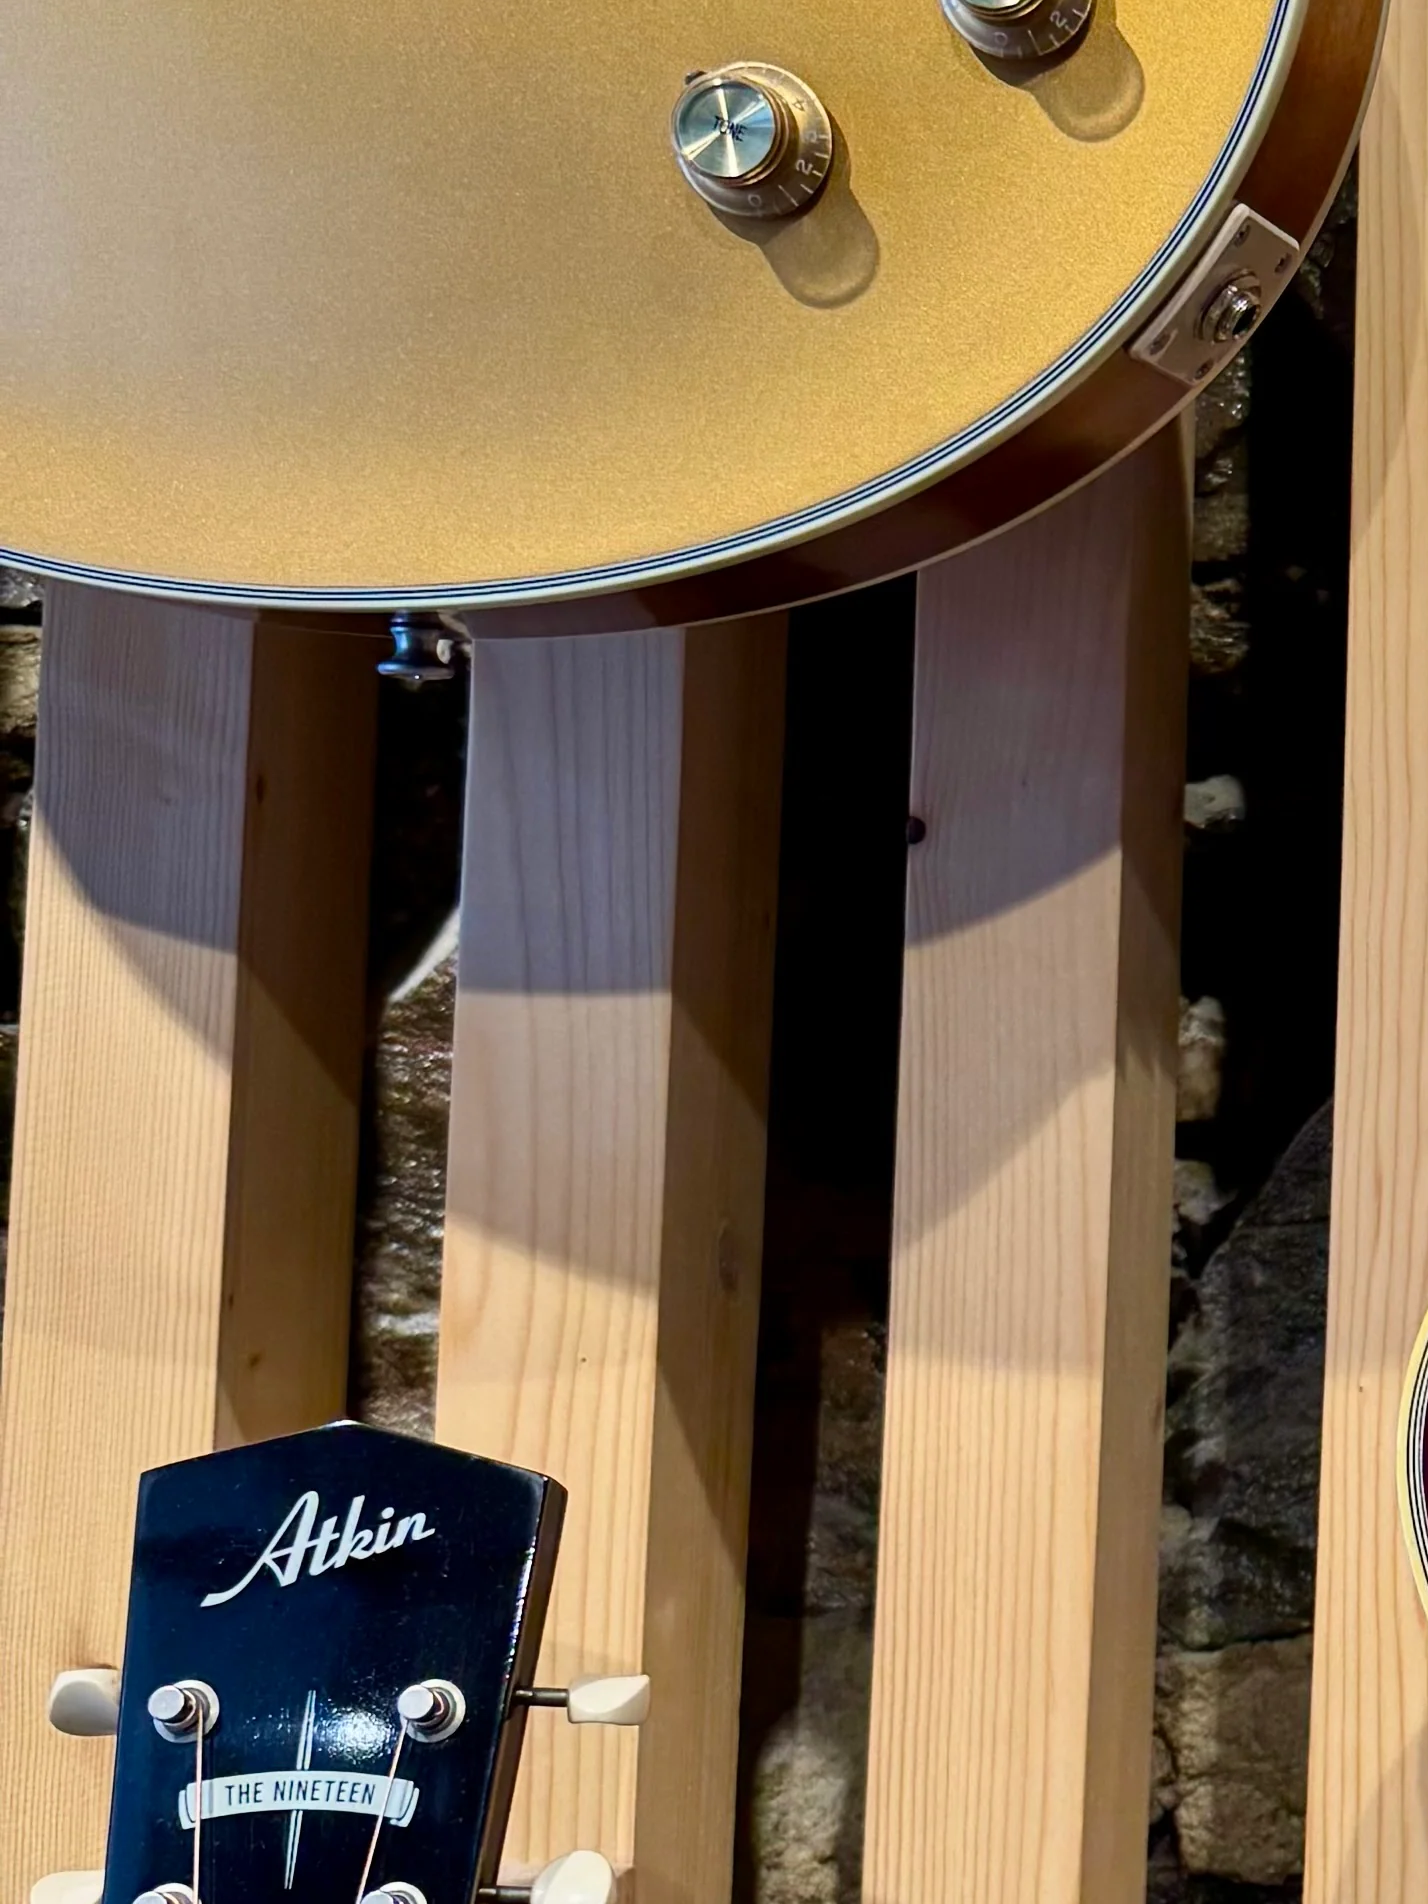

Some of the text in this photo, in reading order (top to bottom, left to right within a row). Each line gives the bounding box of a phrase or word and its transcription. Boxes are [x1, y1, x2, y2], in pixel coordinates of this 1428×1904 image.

[712, 115, 748, 142] TONE
[200, 1490, 436, 1607] Atkin
[225, 1779, 377, 1806] THE NINETEEN
